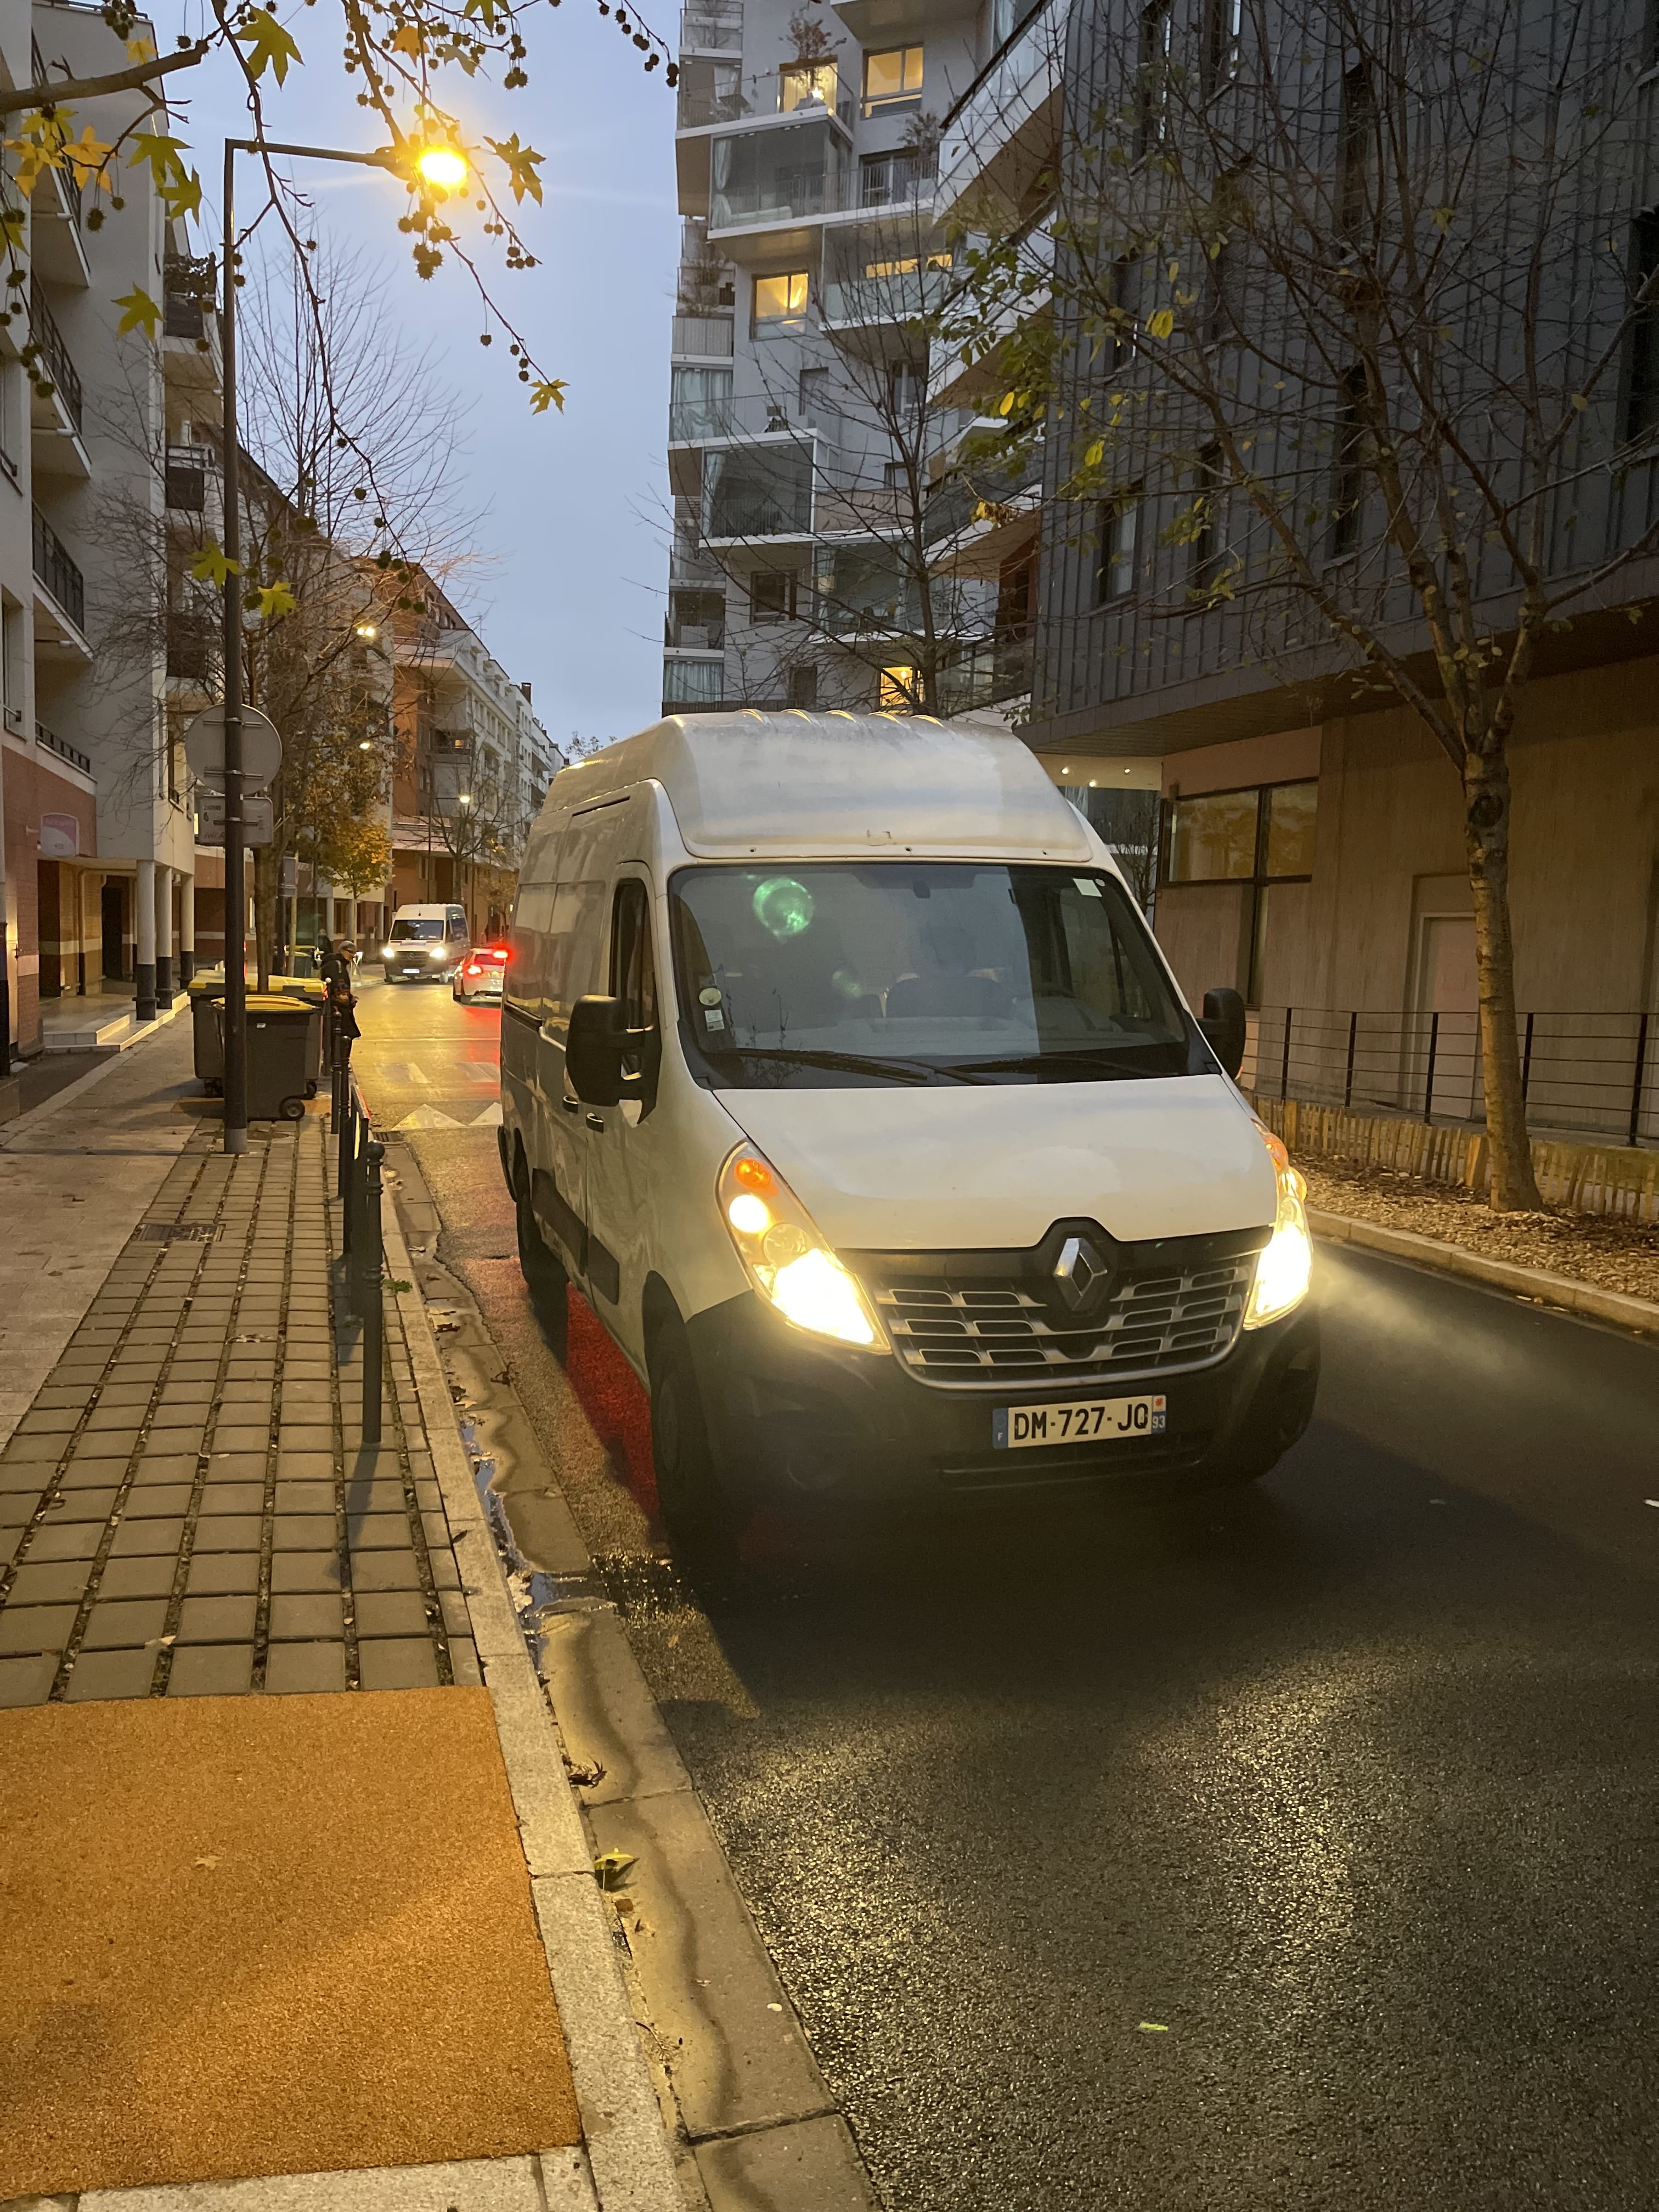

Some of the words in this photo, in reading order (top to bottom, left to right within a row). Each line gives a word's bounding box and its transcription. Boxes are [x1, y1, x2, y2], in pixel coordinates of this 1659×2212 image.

[1014, 1403, 1148, 1440] DM-727-JQ
[1153, 1415, 1165, 1429] 93
[997, 1432, 1003, 1441] F
